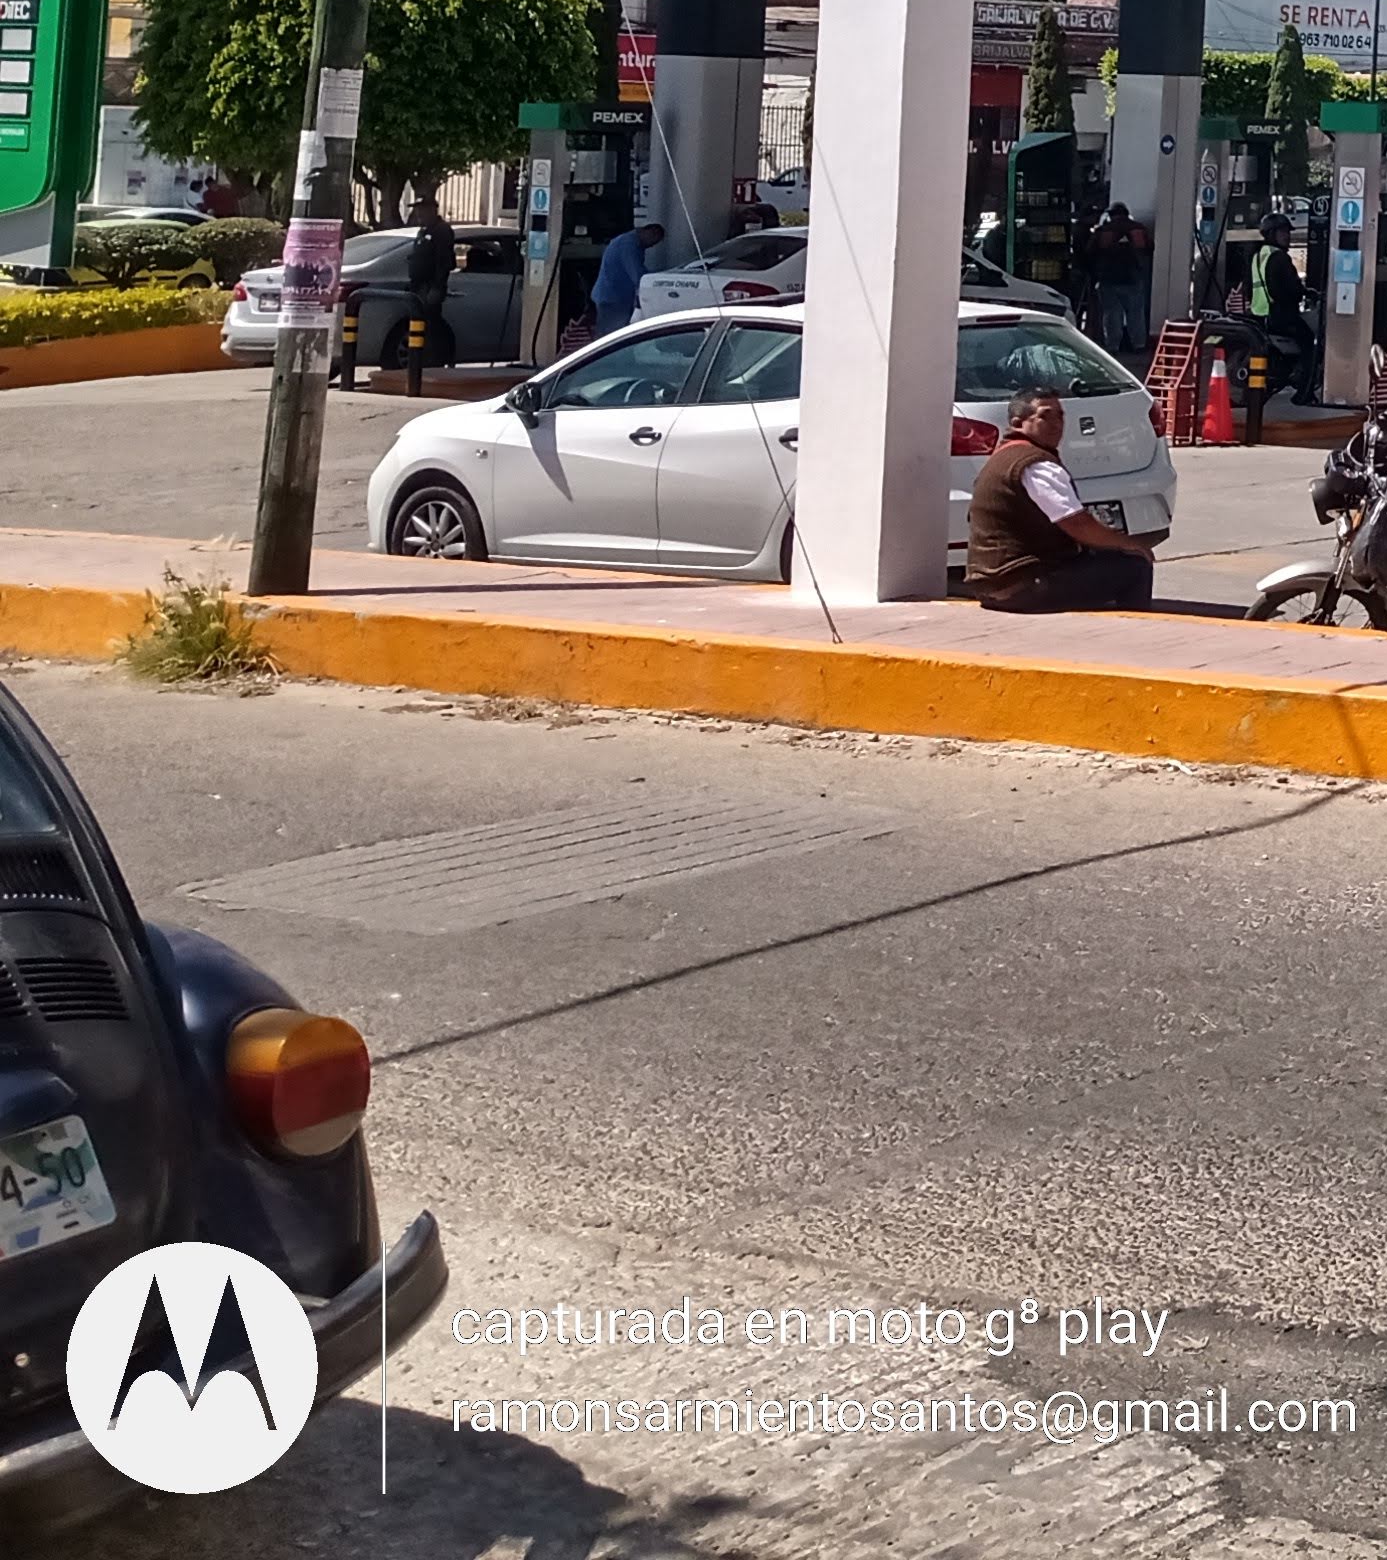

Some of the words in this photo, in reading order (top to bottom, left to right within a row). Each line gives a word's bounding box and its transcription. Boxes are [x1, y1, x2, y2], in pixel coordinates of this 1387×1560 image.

[1280, 4, 1300, 24] SE
[1307, 6, 1371, 29] RENTA
[593, 112, 643, 123] PEMEX
[1247, 125, 1280, 135] PEMEX
